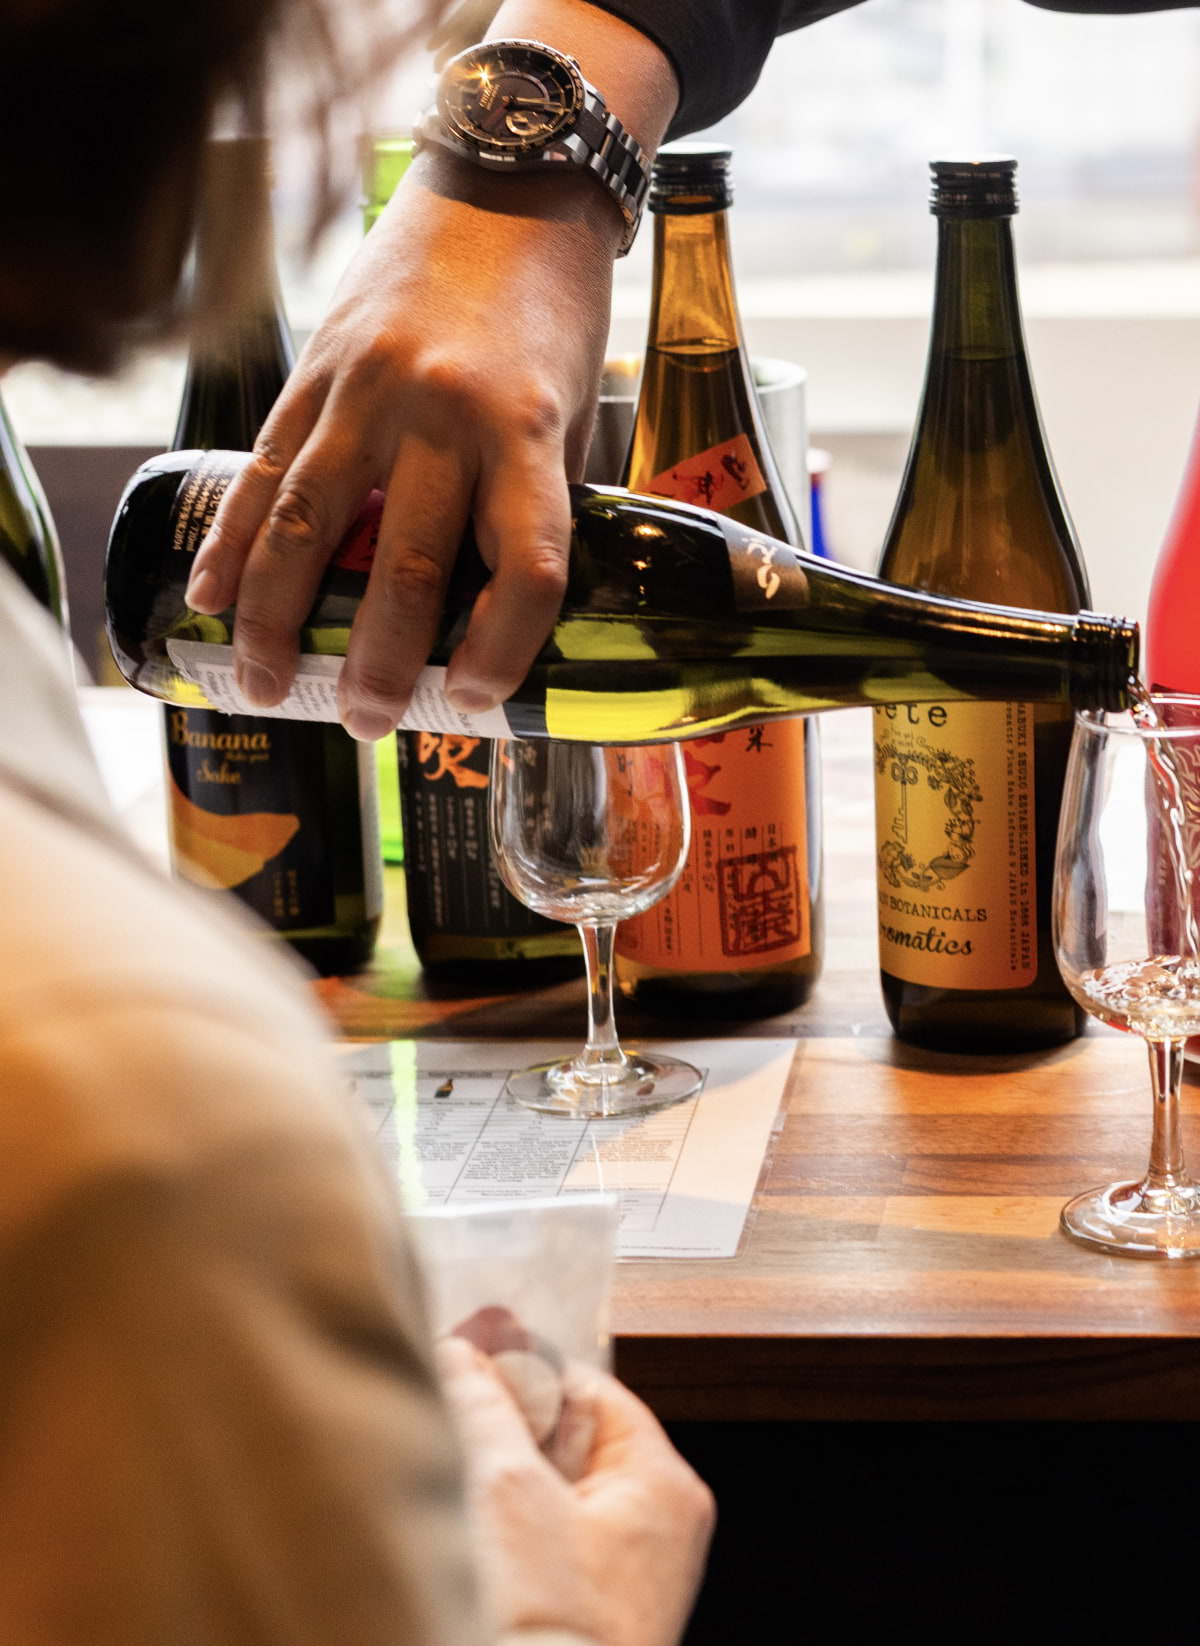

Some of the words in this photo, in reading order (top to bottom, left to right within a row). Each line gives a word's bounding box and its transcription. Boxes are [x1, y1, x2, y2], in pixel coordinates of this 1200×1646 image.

[874, 703, 947, 727] ete
[170, 710, 272, 753] Banana
[889, 896, 988, 922] BOTANICALS
[880, 926, 973, 956] romatics
